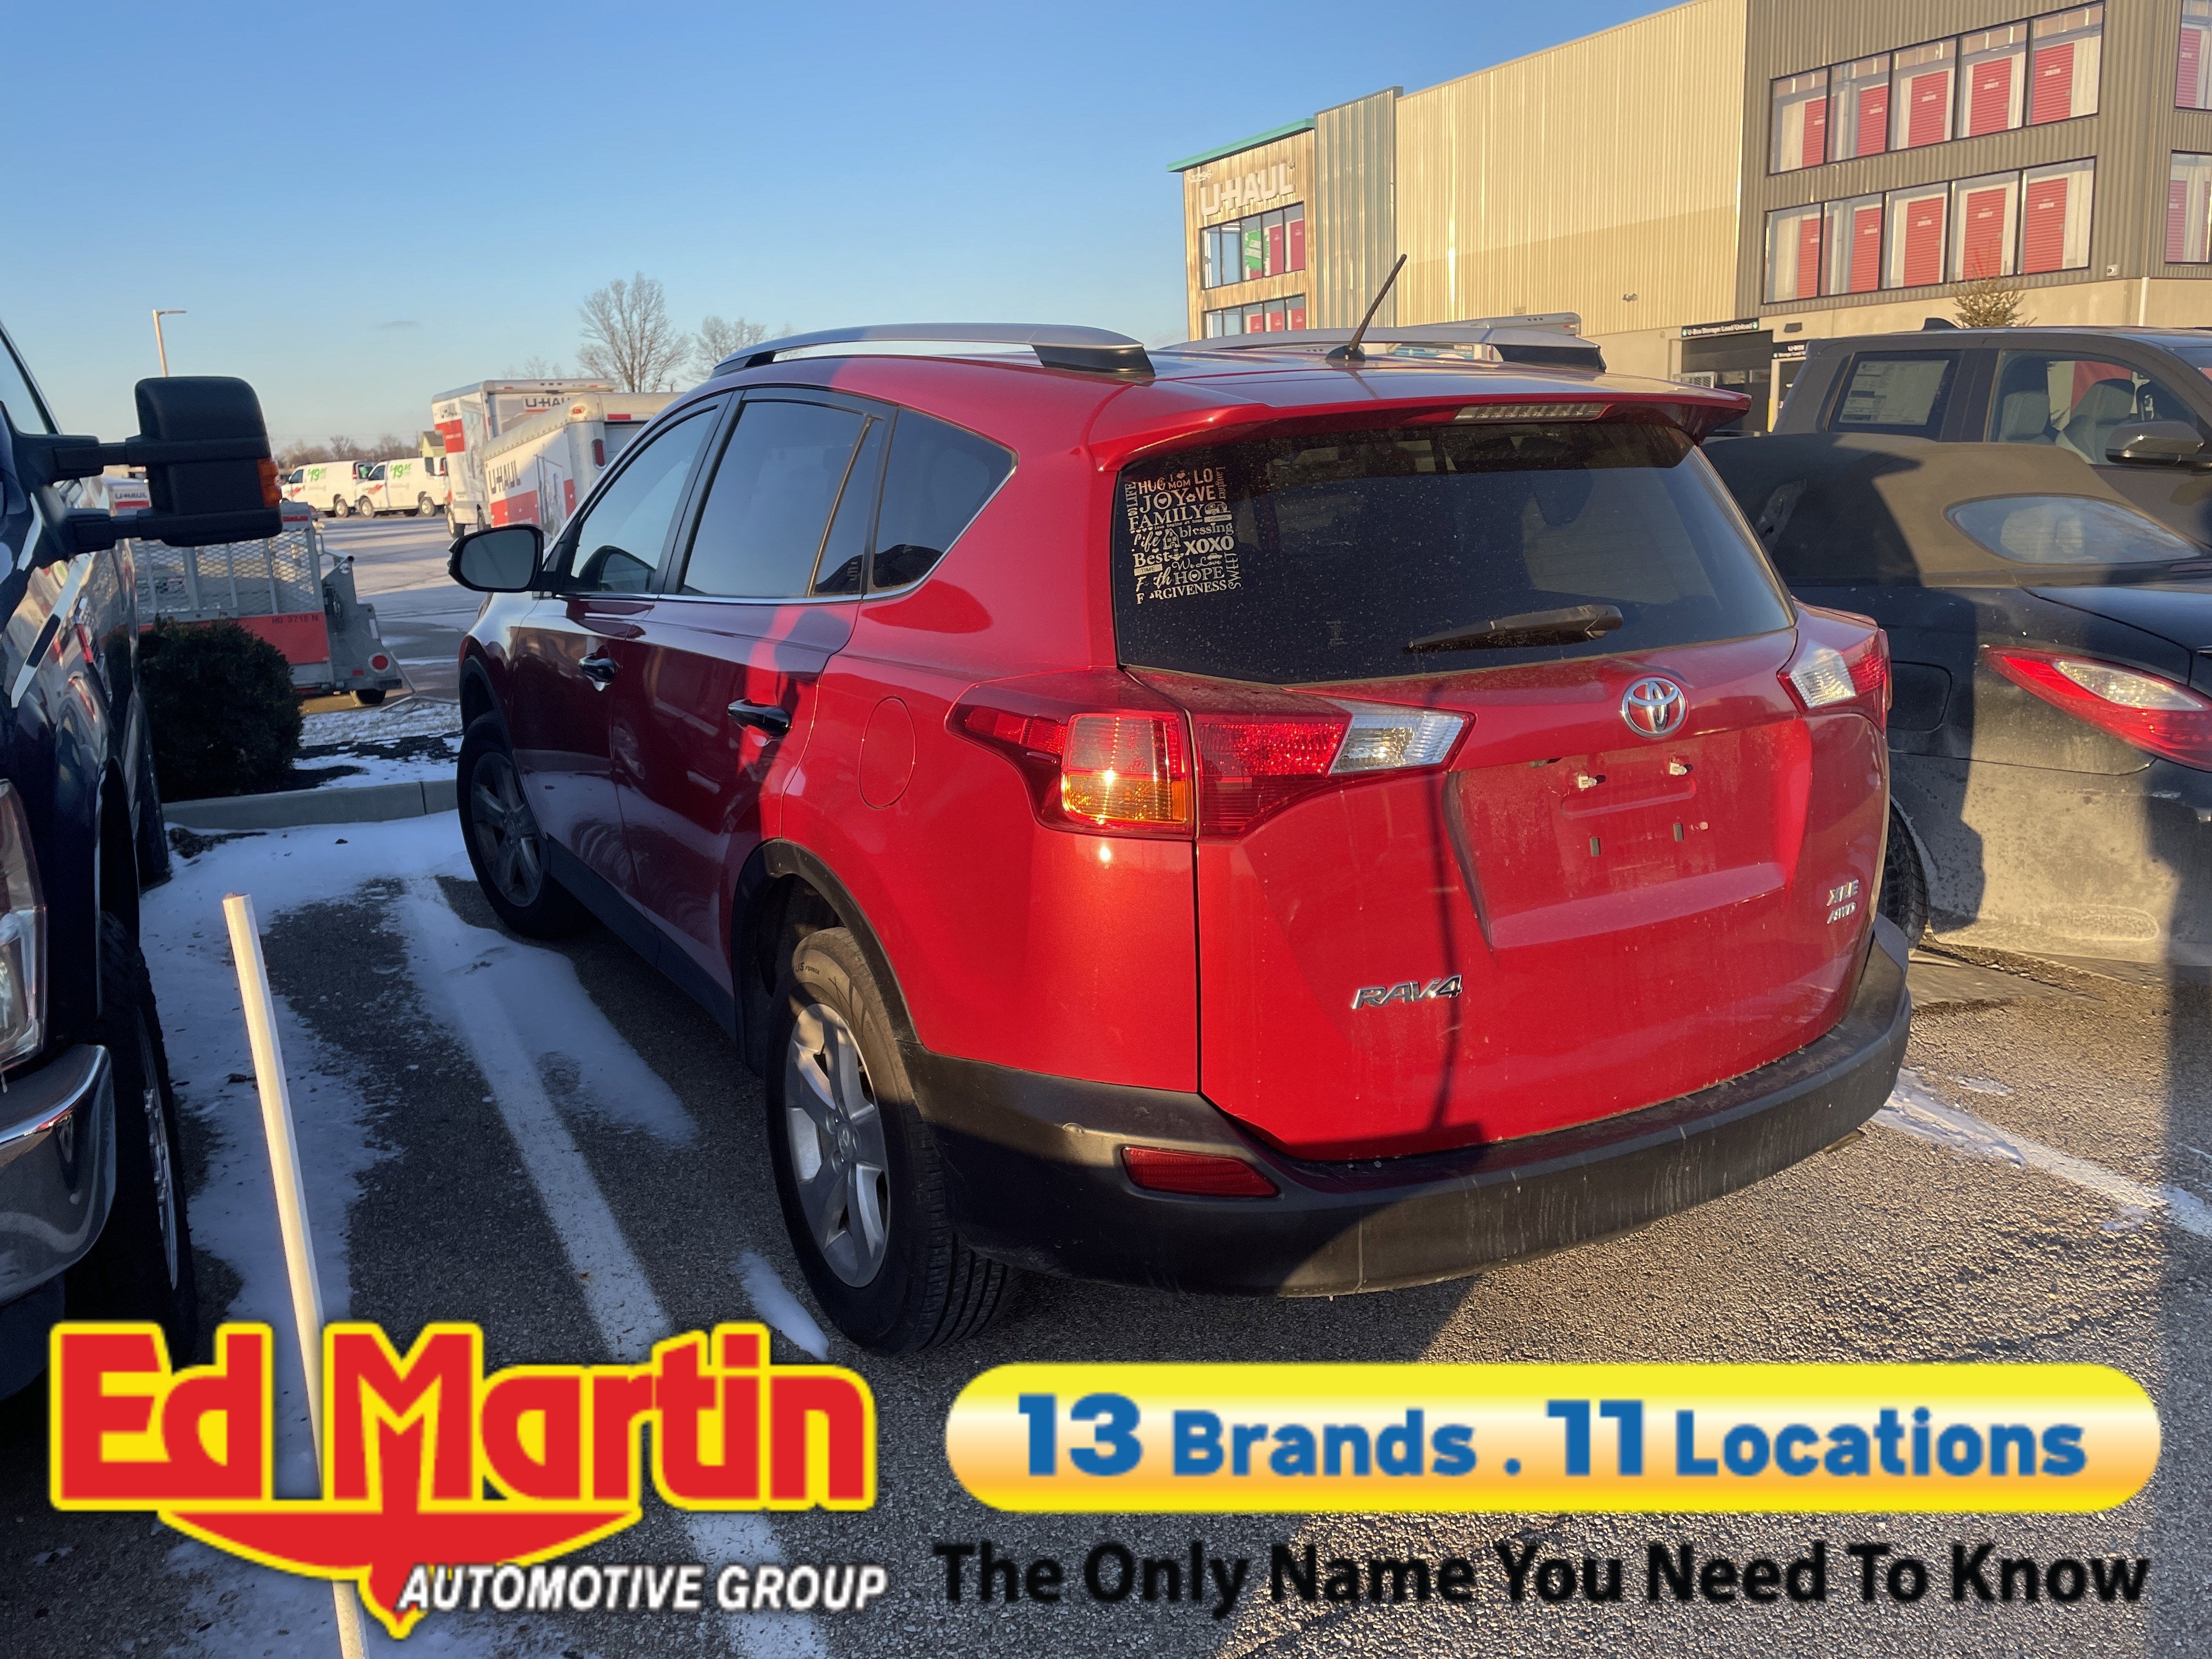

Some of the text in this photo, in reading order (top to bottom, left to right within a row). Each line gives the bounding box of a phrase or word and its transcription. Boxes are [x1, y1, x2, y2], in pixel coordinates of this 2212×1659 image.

[1200, 163, 1296, 216] U-HAUL
[1138, 476, 1166, 494] HUG
[1167, 478, 1190, 489] MOM
[1139, 487, 1189, 514] JOY
[1128, 503, 1205, 531] FAMILY
[1183, 535, 1234, 556] XOXO
[1132, 551, 1170, 568] Best
[1173, 566, 1224, 585] HOPE
[1351, 974, 1463, 1009] RAV4
